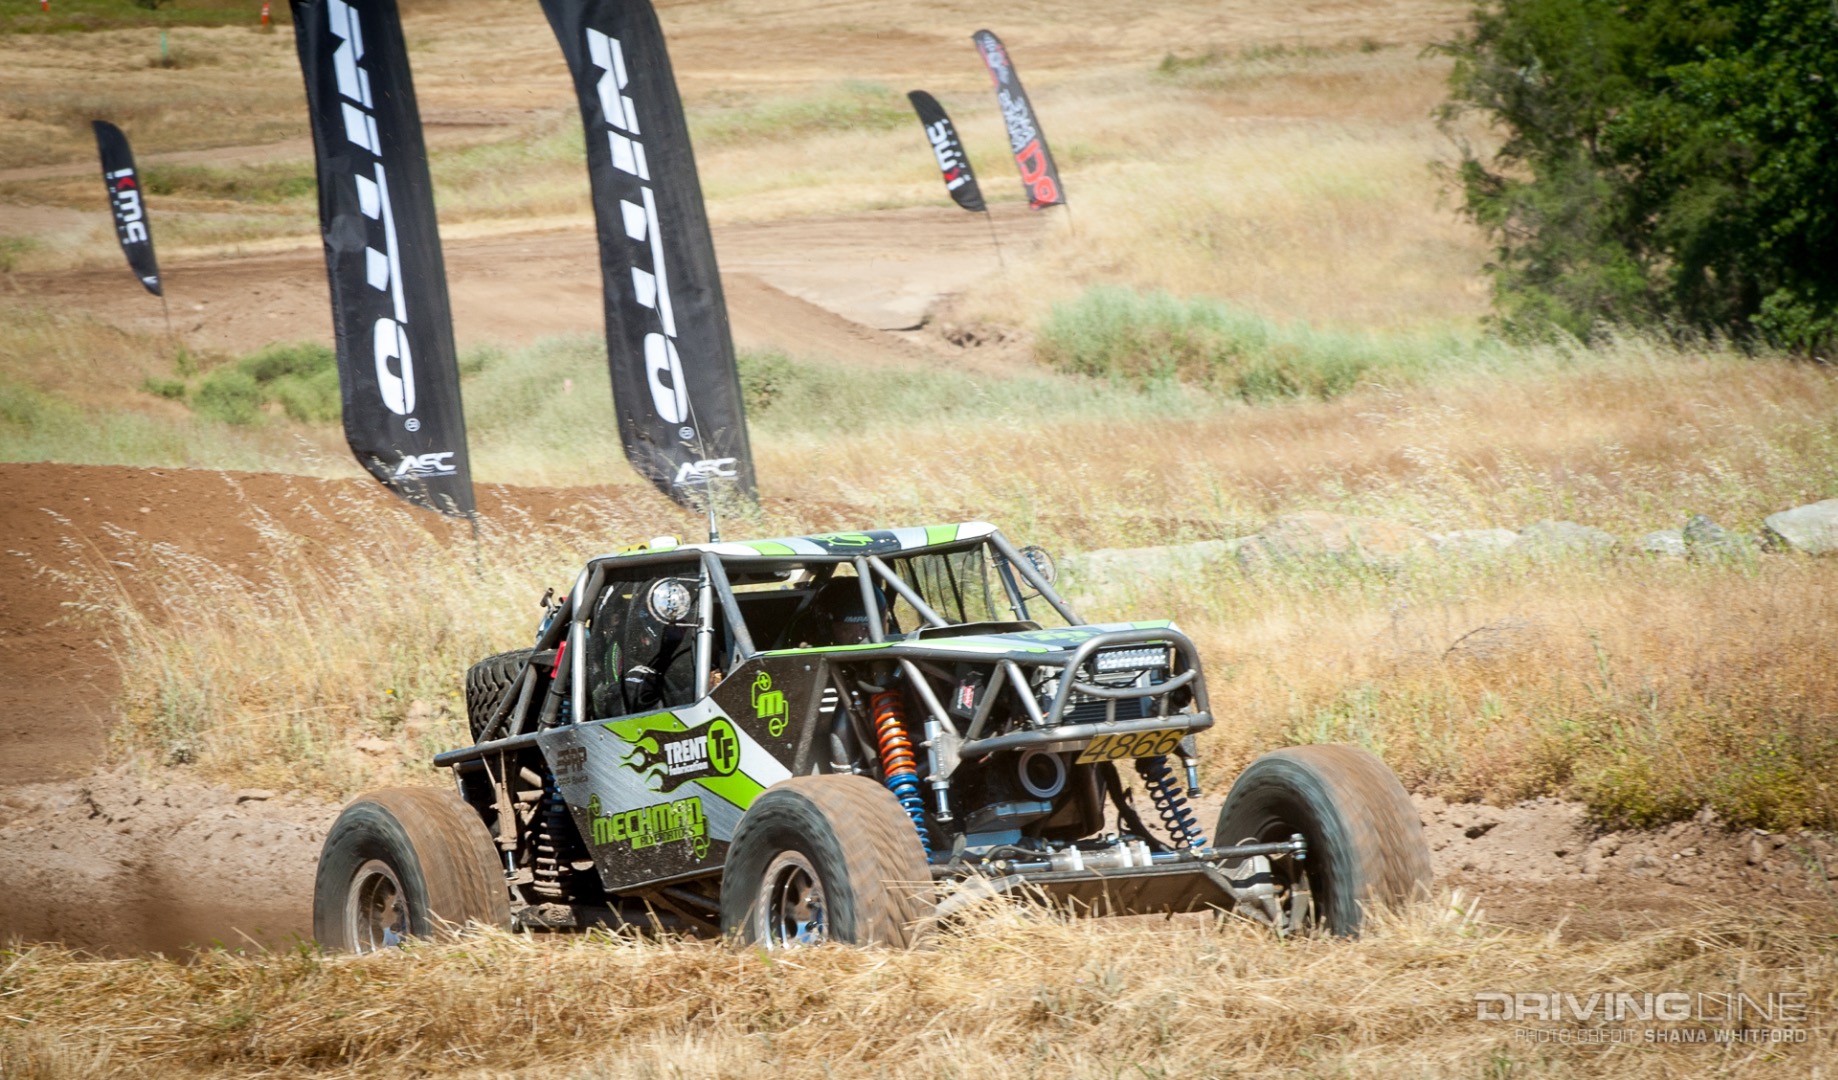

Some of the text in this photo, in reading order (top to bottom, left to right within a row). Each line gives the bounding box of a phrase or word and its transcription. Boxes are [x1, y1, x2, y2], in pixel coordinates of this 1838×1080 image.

[327, 0, 416, 415] NITTO
[586, 27, 689, 424] NITTO
[394, 451, 457, 475] ASC
[674, 457, 738, 482] ASC
[664, 735, 708, 765] TRENT
[711, 729, 734, 769] TF
[1083, 728, 1184, 761] 4866
